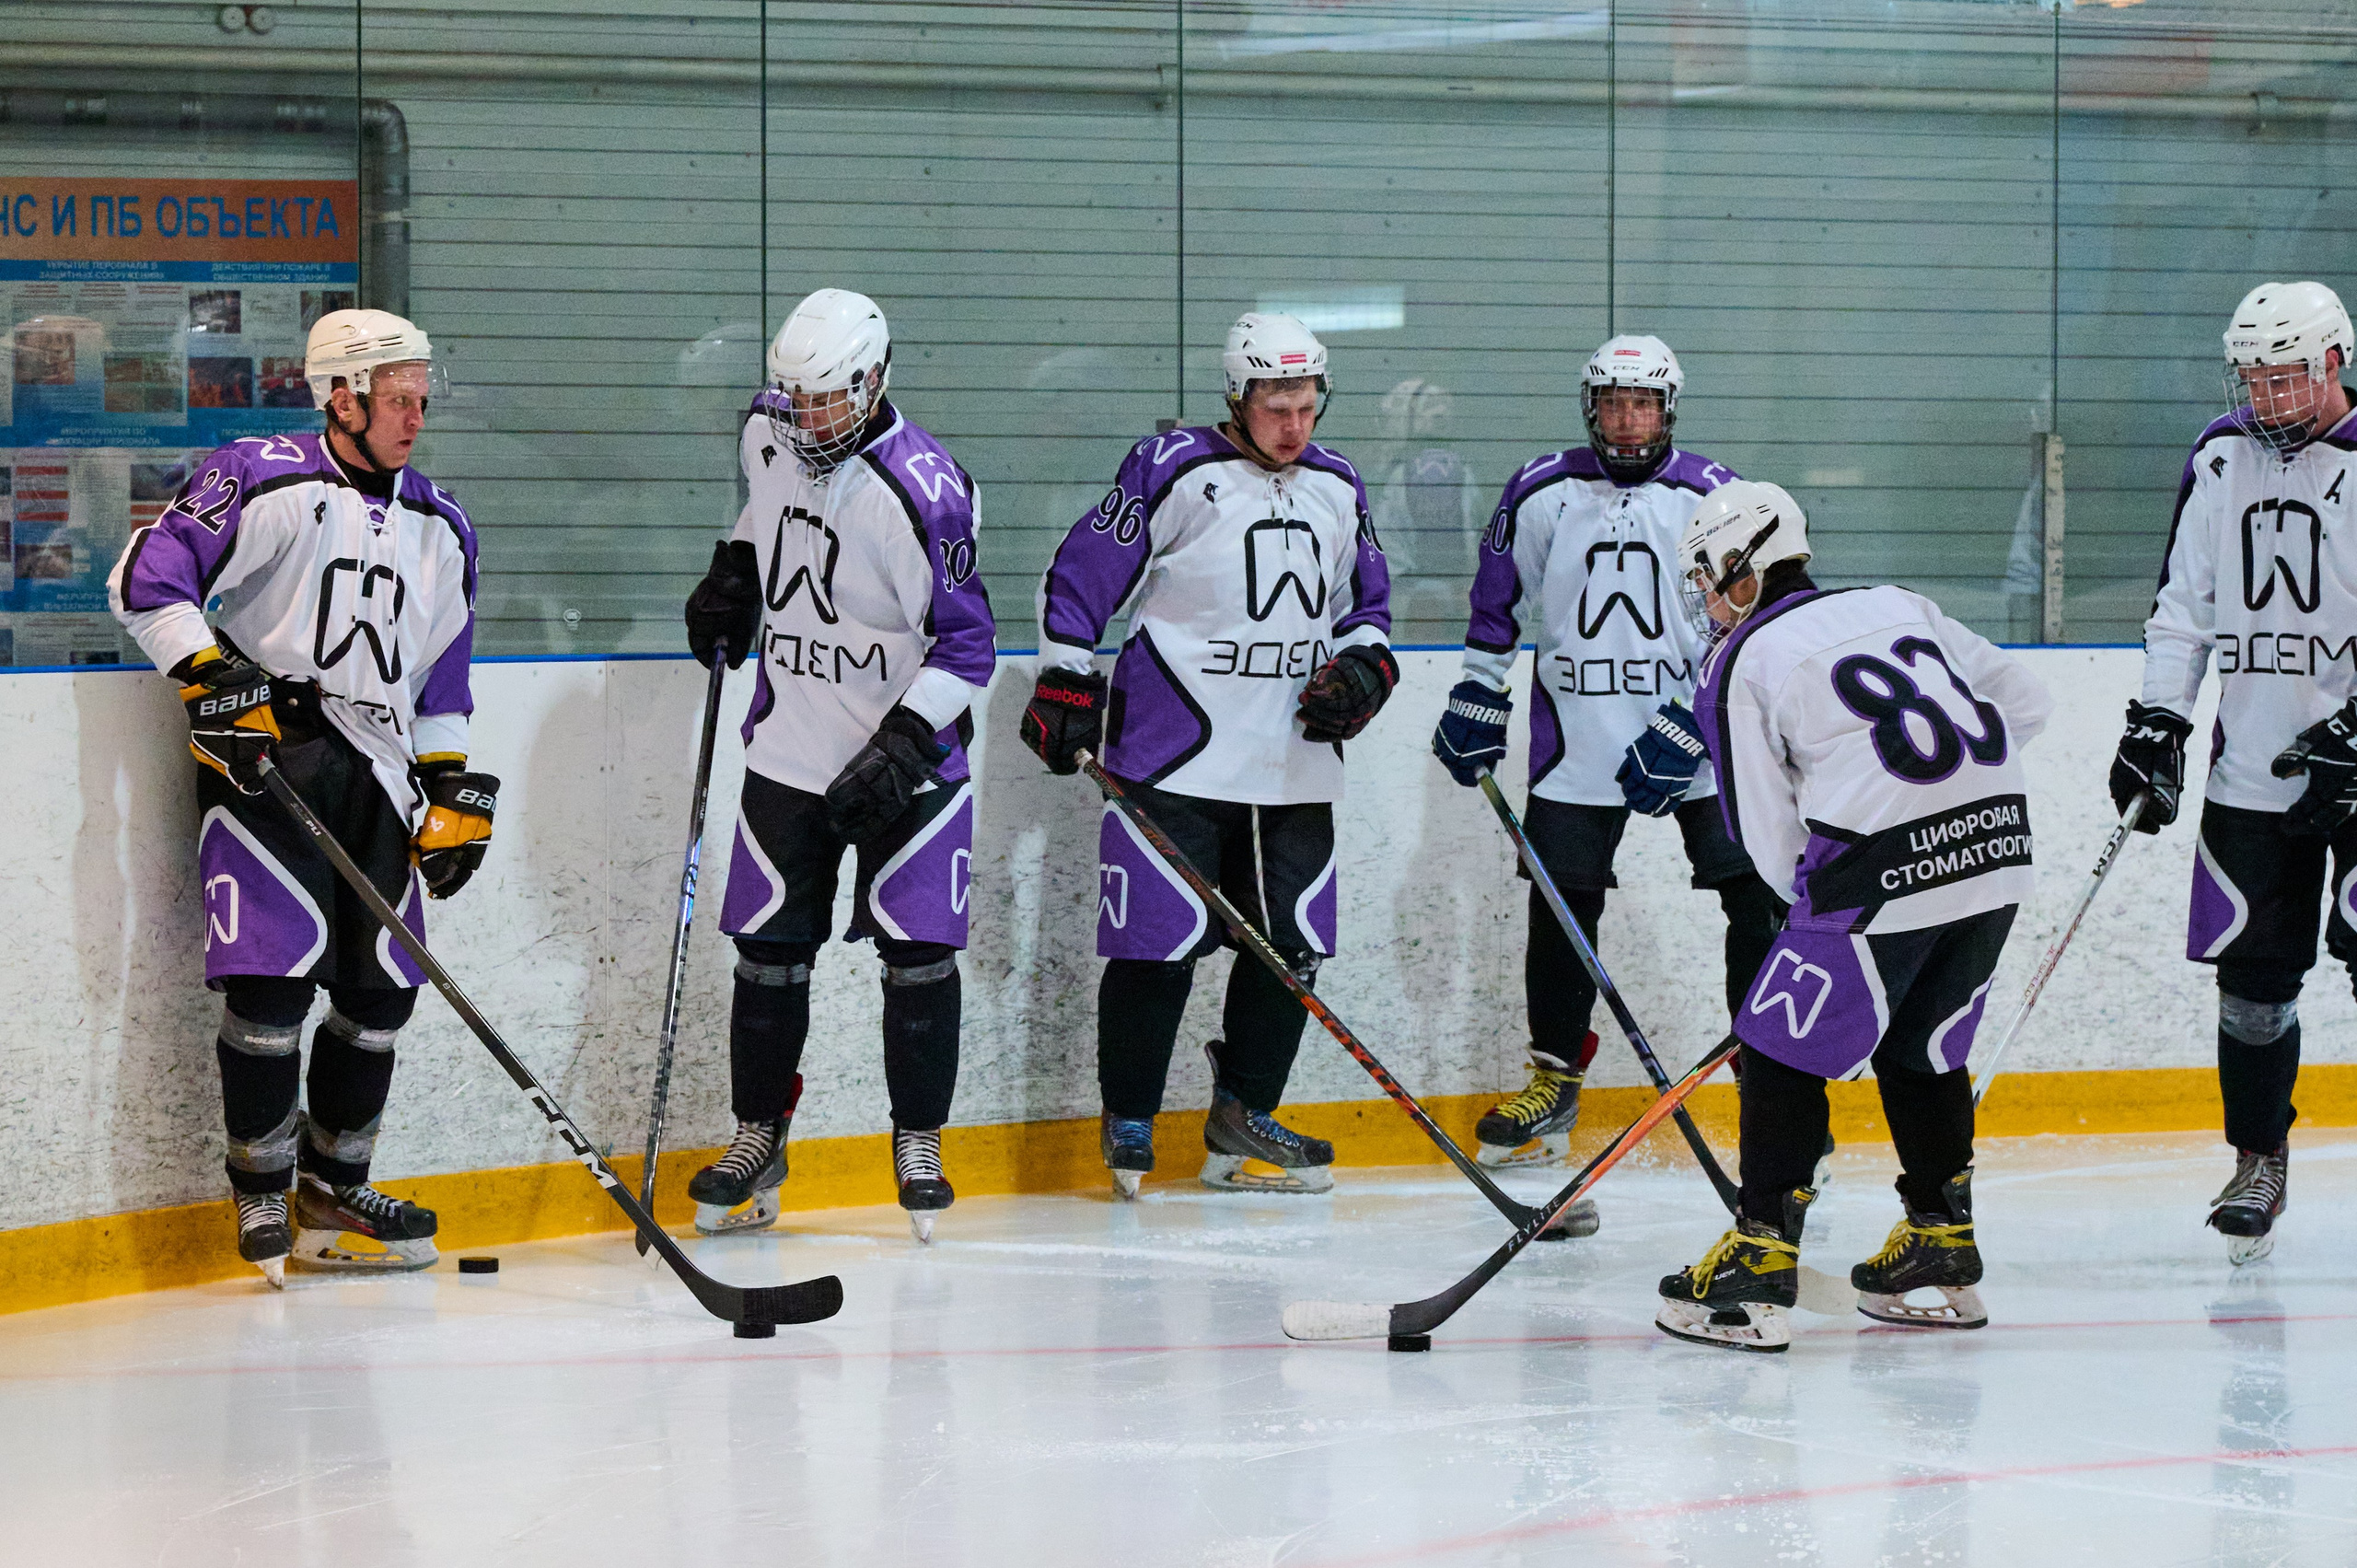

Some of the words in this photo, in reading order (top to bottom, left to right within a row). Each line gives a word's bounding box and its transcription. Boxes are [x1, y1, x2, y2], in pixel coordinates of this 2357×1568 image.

[52, 194, 75, 237] И
[90, 195, 142, 238] ПБ
[156, 195, 340, 238] ОБЪЕКТА
[184, 469, 241, 536] 22
[2323, 469, 2346, 505] A
[1091, 485, 1144, 546] 96
[1037, 684, 1094, 708] Reebok
[1554, 655, 1695, 696] ЭДЕМ
[1449, 697, 1512, 726] WARRIO
[1652, 713, 1704, 757] RRIOR
[2092, 824, 2125, 877] CCM
[1507, 1197, 1562, 1252] FLYLITE
